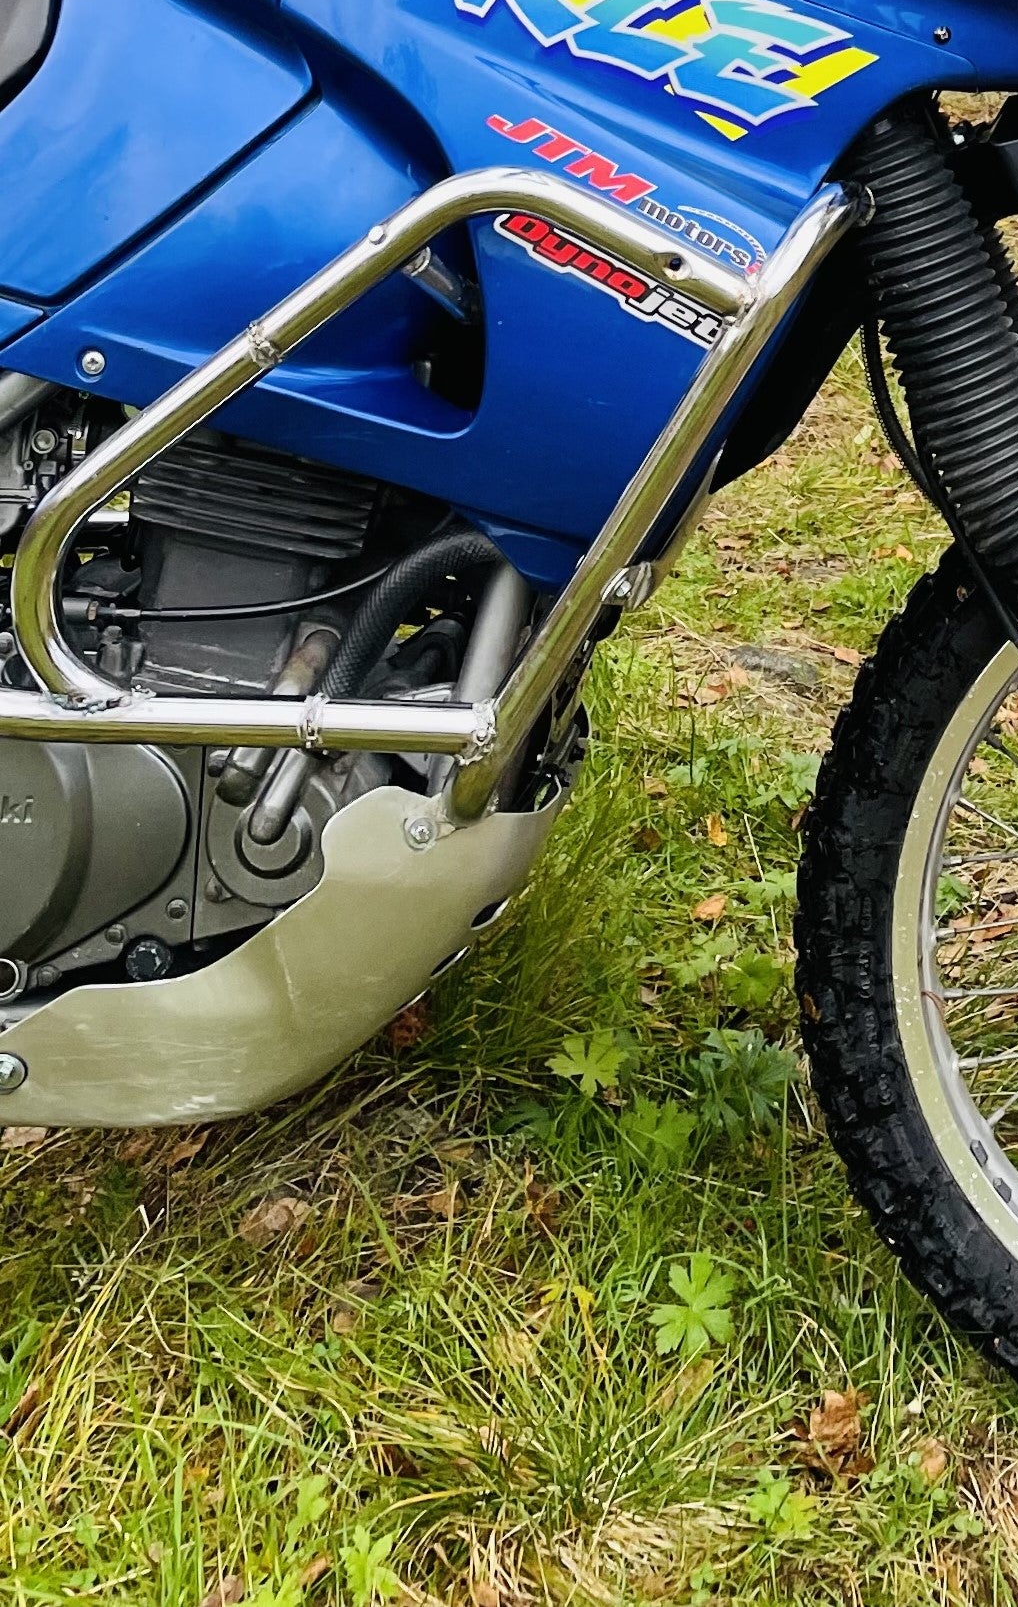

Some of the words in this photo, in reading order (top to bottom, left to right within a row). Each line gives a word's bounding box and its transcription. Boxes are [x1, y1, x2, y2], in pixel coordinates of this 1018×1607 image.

[486, 113, 659, 205] JTM
[635, 196, 753, 271] motors
[498, 212, 725, 345] Dynojet
